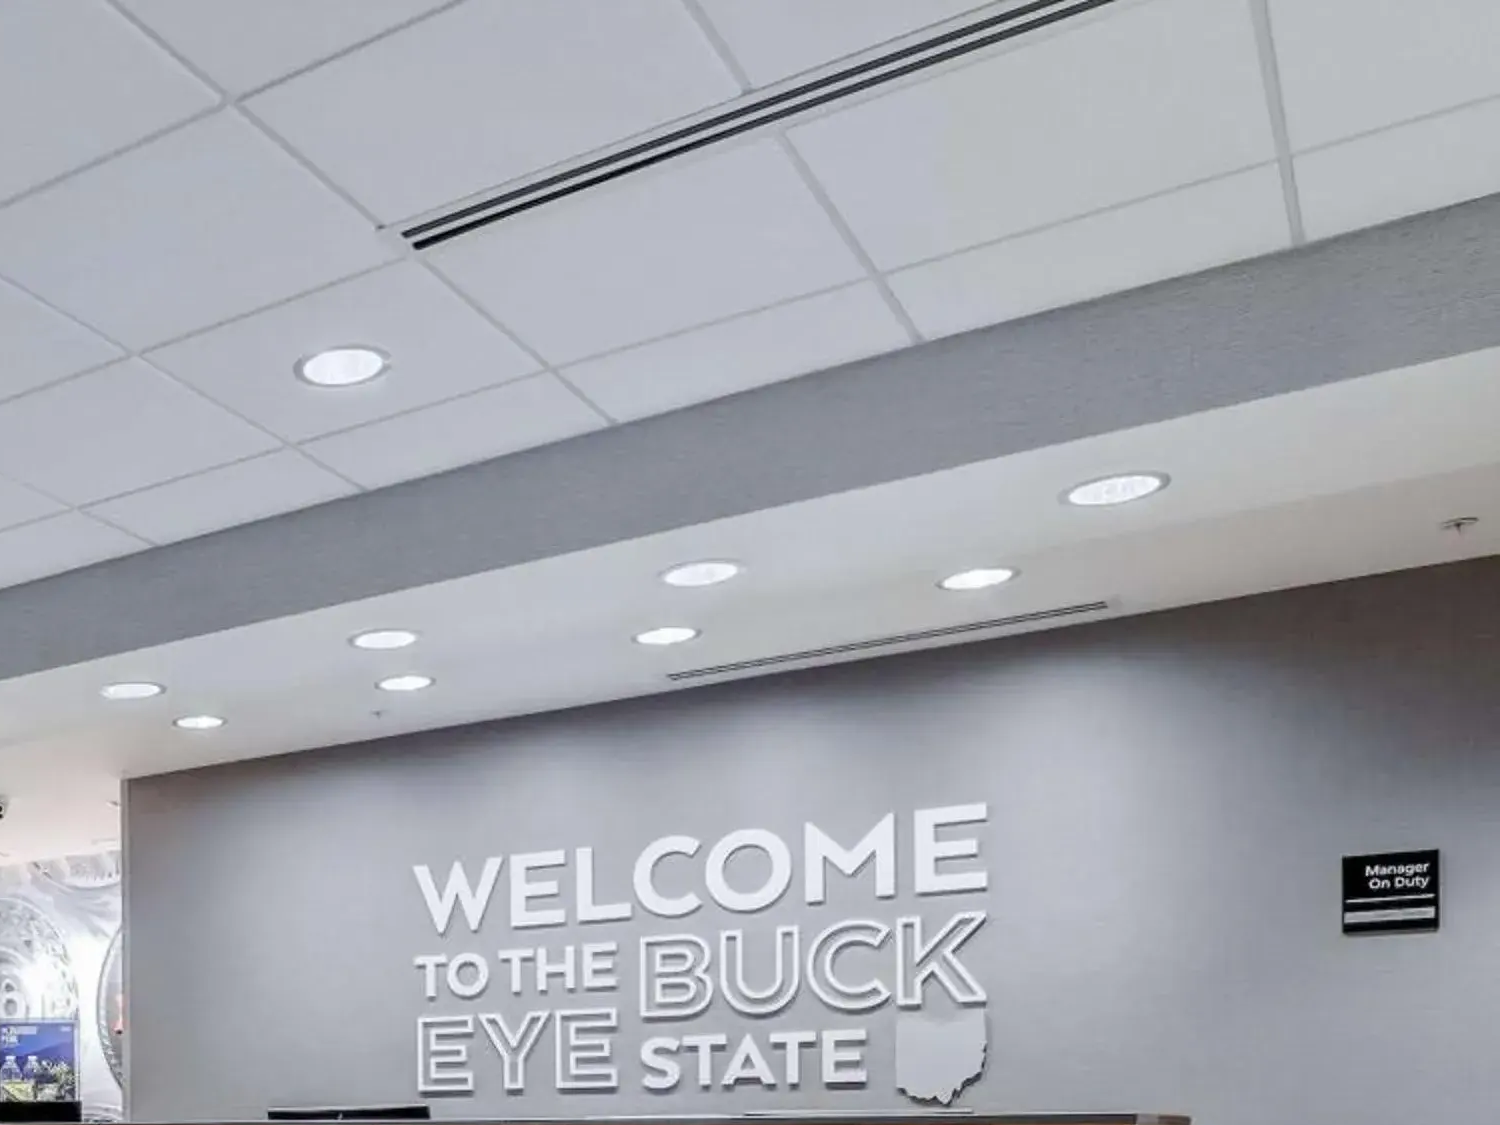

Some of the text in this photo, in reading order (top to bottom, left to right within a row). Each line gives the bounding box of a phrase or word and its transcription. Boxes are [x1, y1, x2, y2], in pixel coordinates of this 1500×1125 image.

[412, 802, 988, 934] WELCOME
[1365, 862, 1429, 876] Manager
[1369, 876, 1429, 889] On Duty
[414, 911, 987, 1020] TO THE BUCK
[417, 1007, 867, 1095] EYE STATE
